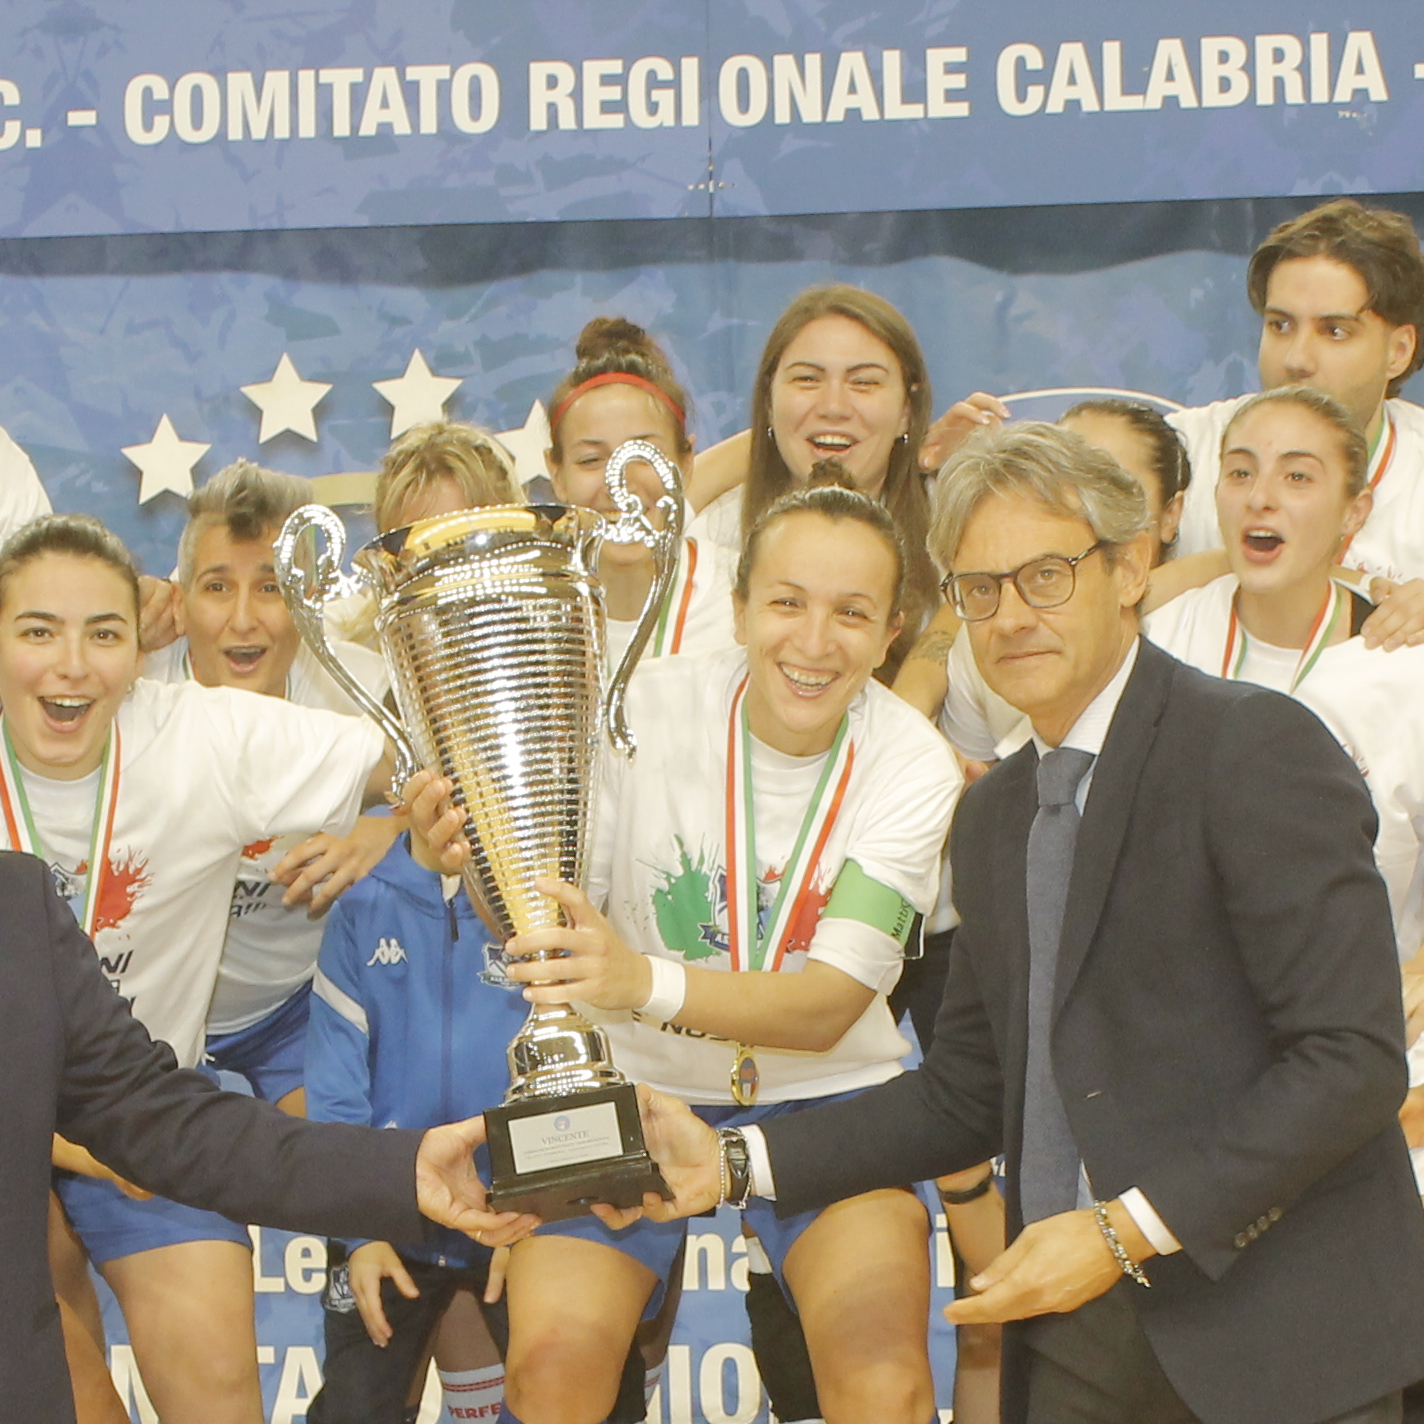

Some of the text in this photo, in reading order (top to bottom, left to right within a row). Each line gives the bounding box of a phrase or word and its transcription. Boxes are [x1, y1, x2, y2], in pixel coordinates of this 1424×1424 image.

[123, 62, 500, 144] COMITATO
[997, 30, 1387, 114] CALABRIA
[541, 1130, 590, 1146] VINCENTE
